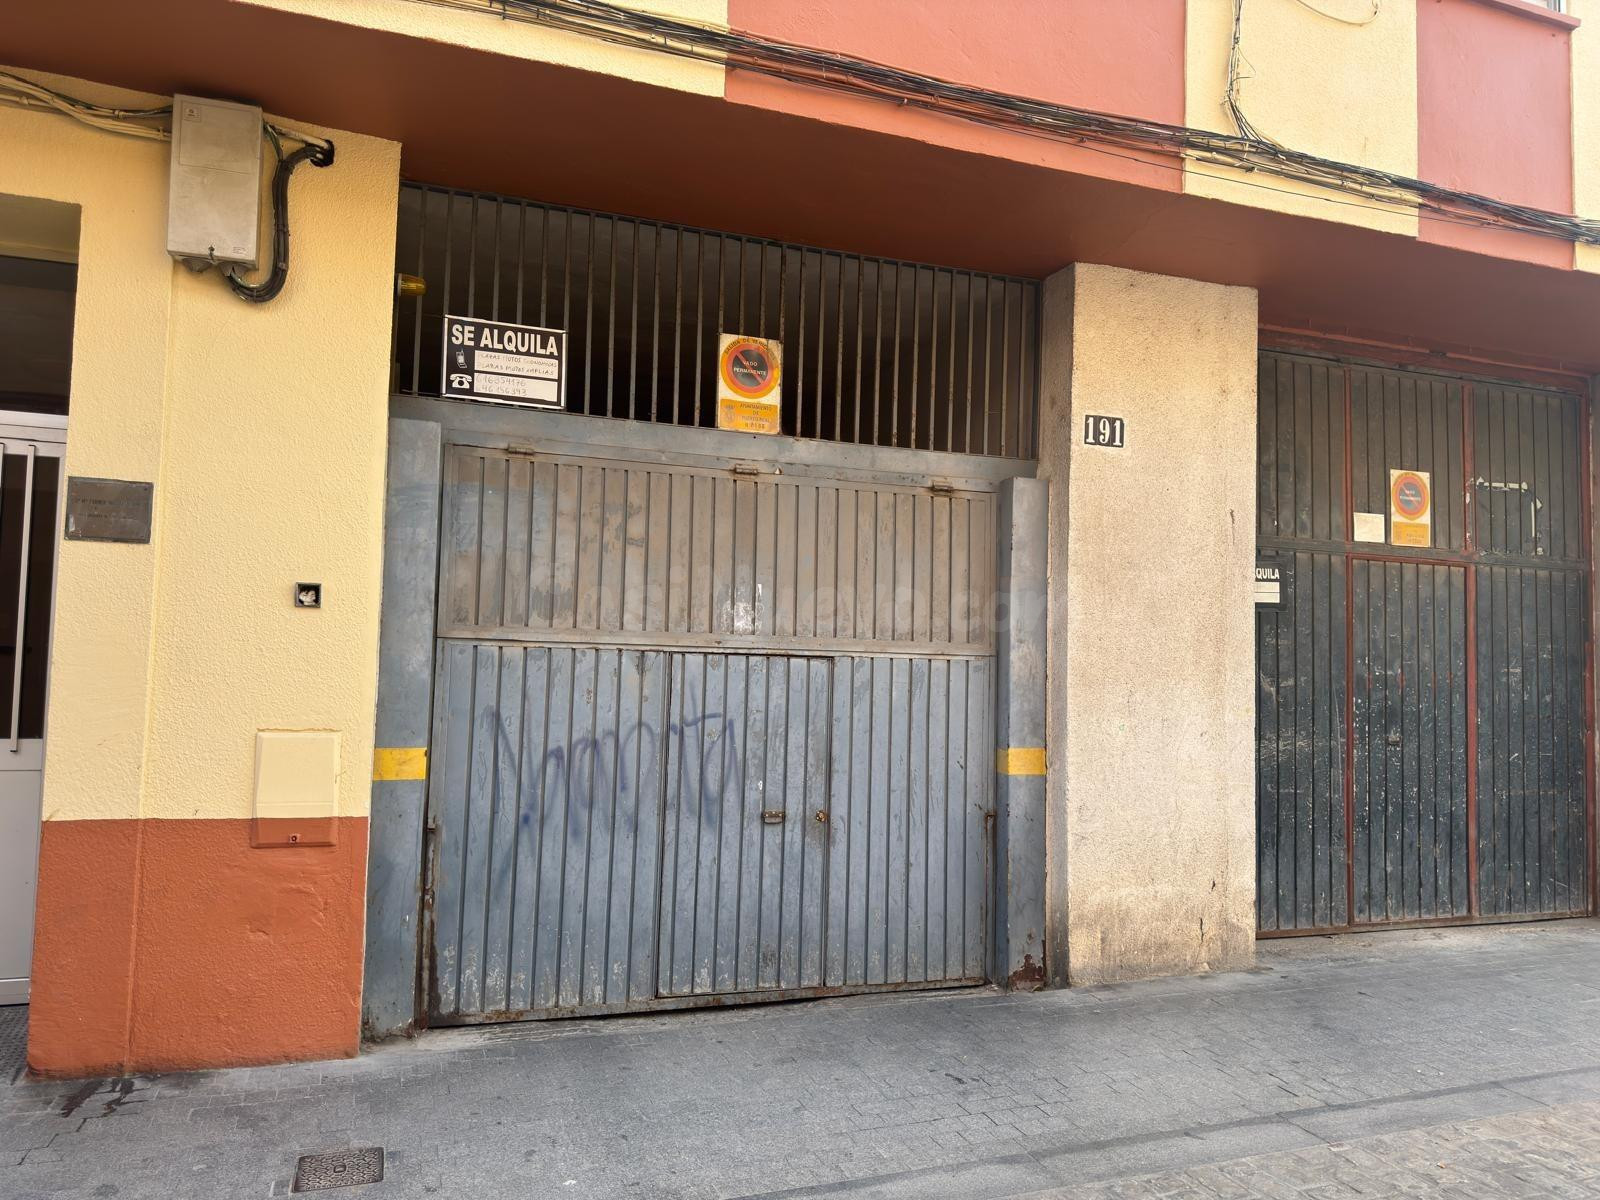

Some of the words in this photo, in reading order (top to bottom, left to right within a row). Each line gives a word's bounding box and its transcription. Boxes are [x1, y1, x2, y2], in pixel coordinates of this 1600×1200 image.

[451, 324, 475, 346] SE
[479, 327, 559, 356] ALQUILA
[733, 367, 767, 376] PERMANENTE
[1086, 417, 1122, 446] 191
